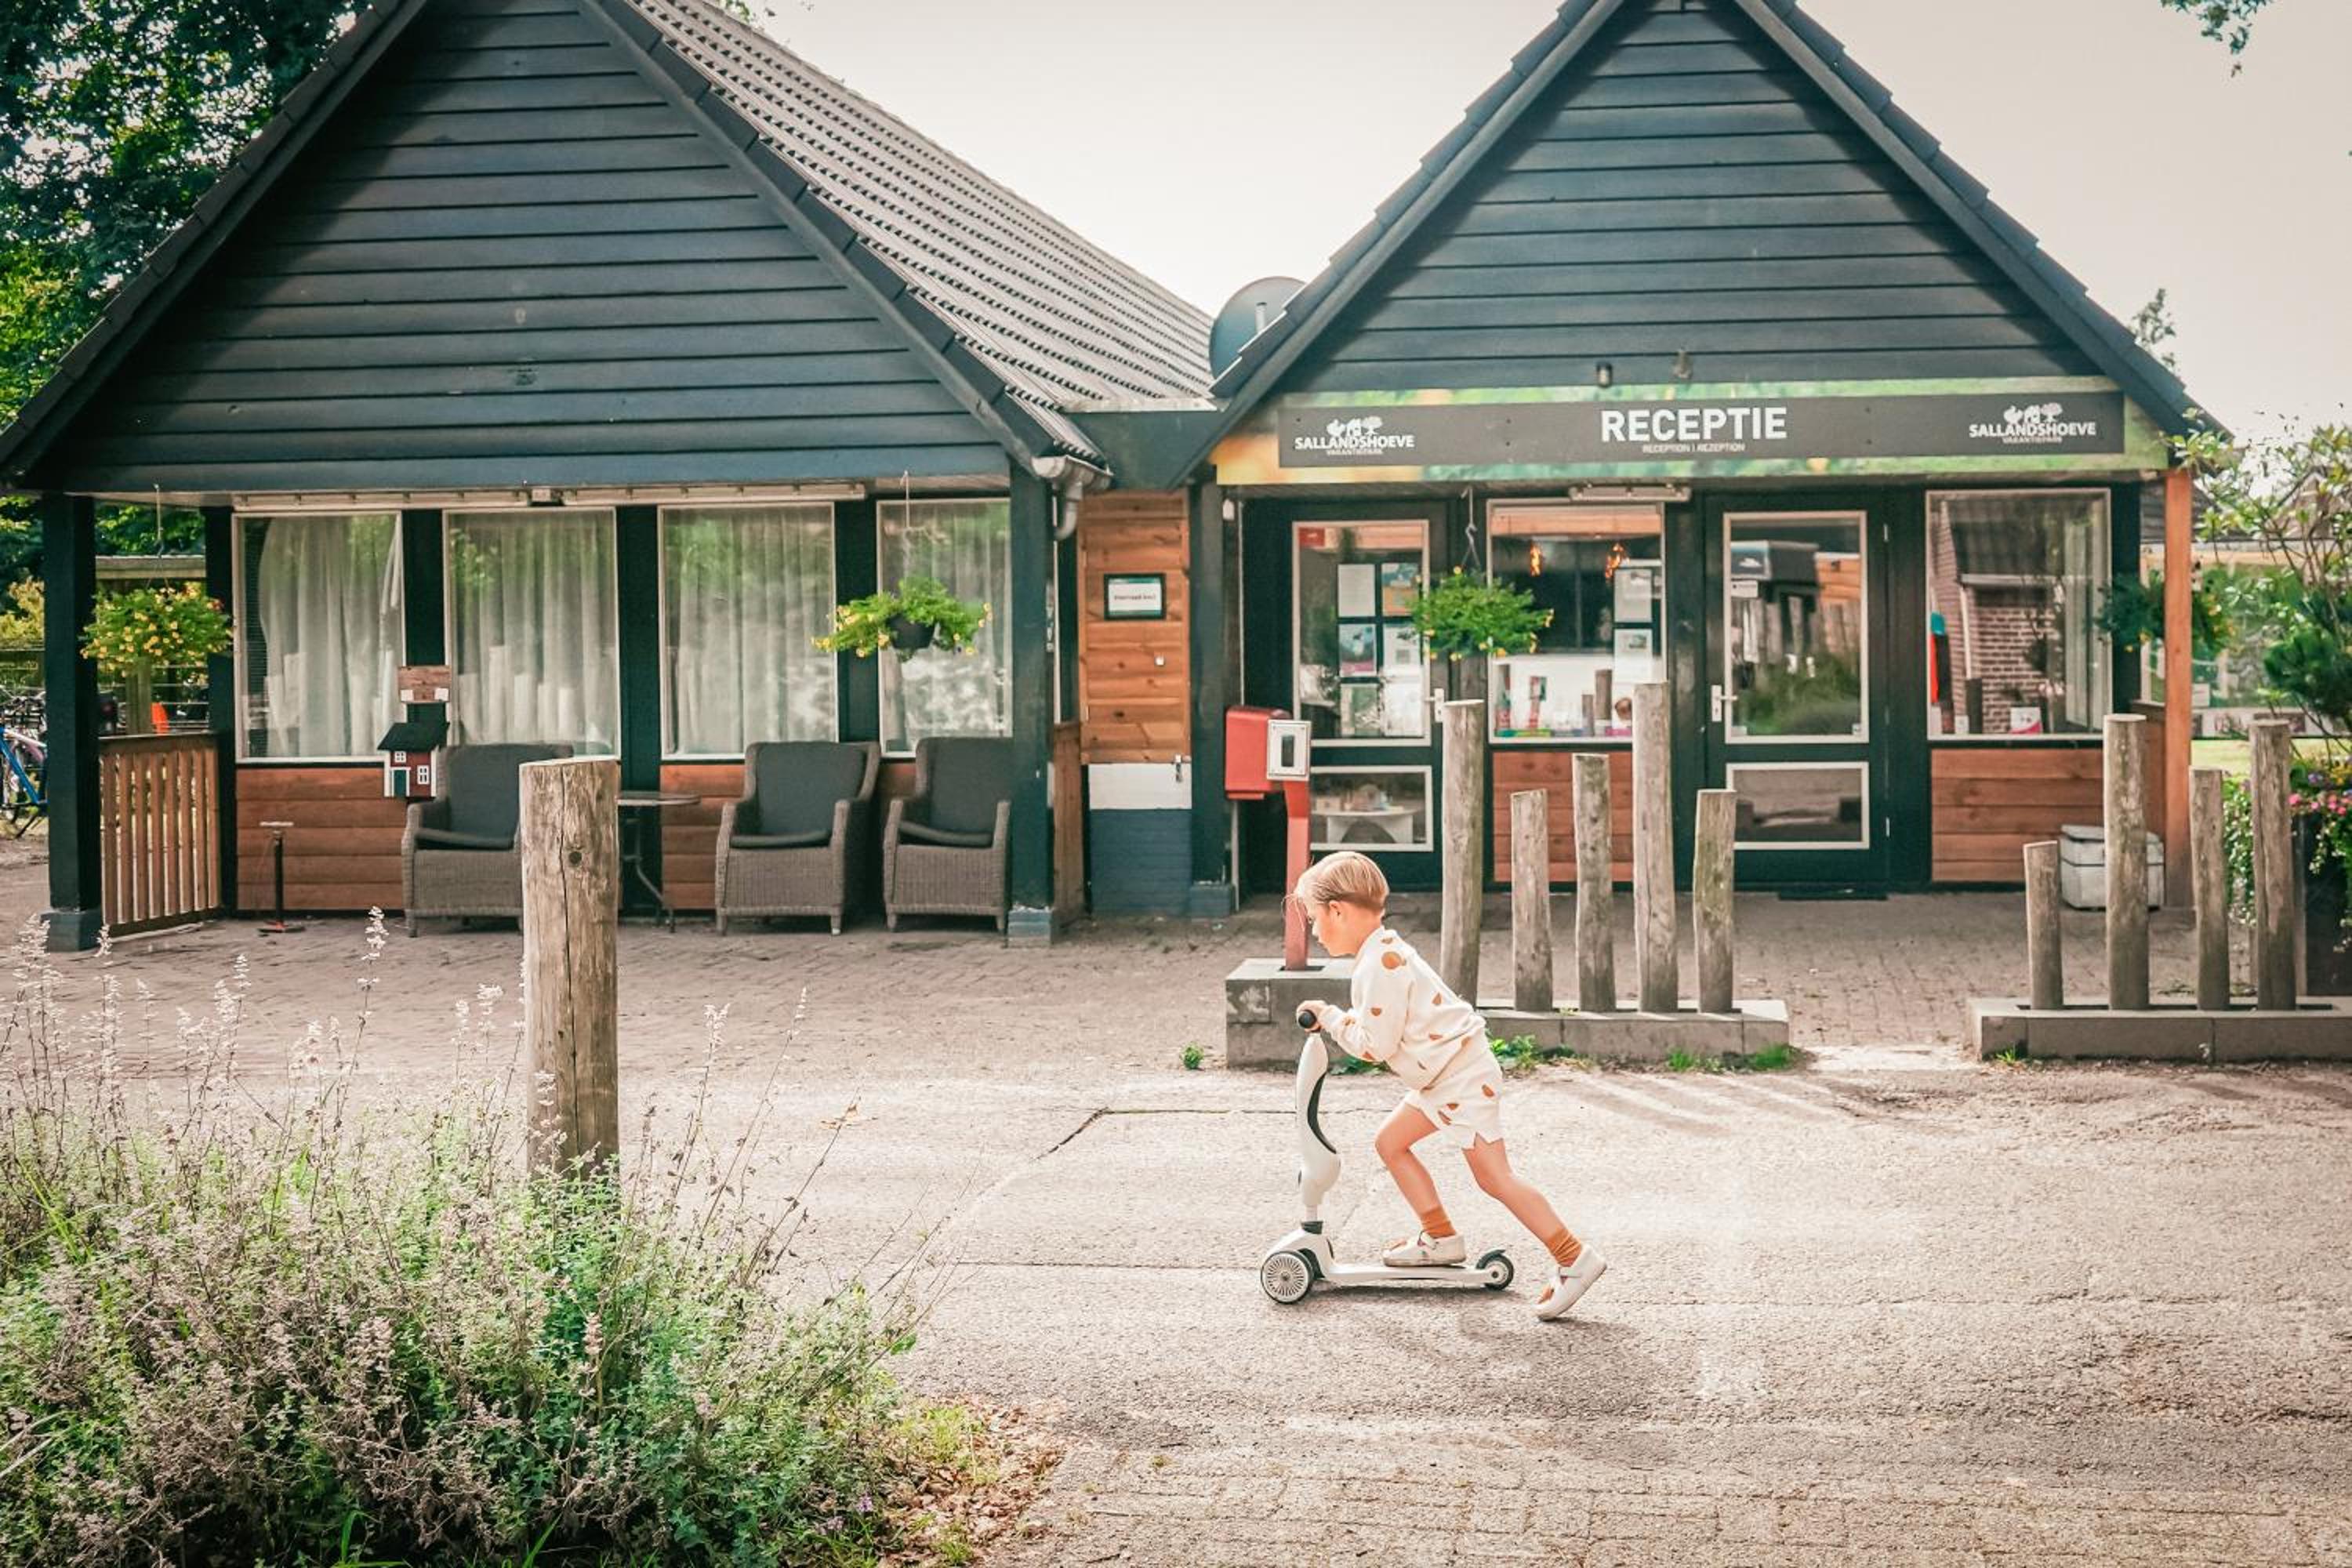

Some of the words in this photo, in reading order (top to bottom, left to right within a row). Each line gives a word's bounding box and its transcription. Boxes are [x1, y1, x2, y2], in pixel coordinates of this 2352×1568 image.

[1601, 407, 1788, 443] RECEPTIE
[1969, 421, 2096, 437] SALLANDSHOEVE
[1294, 434, 1415, 450] SALLANDSHOEVE
